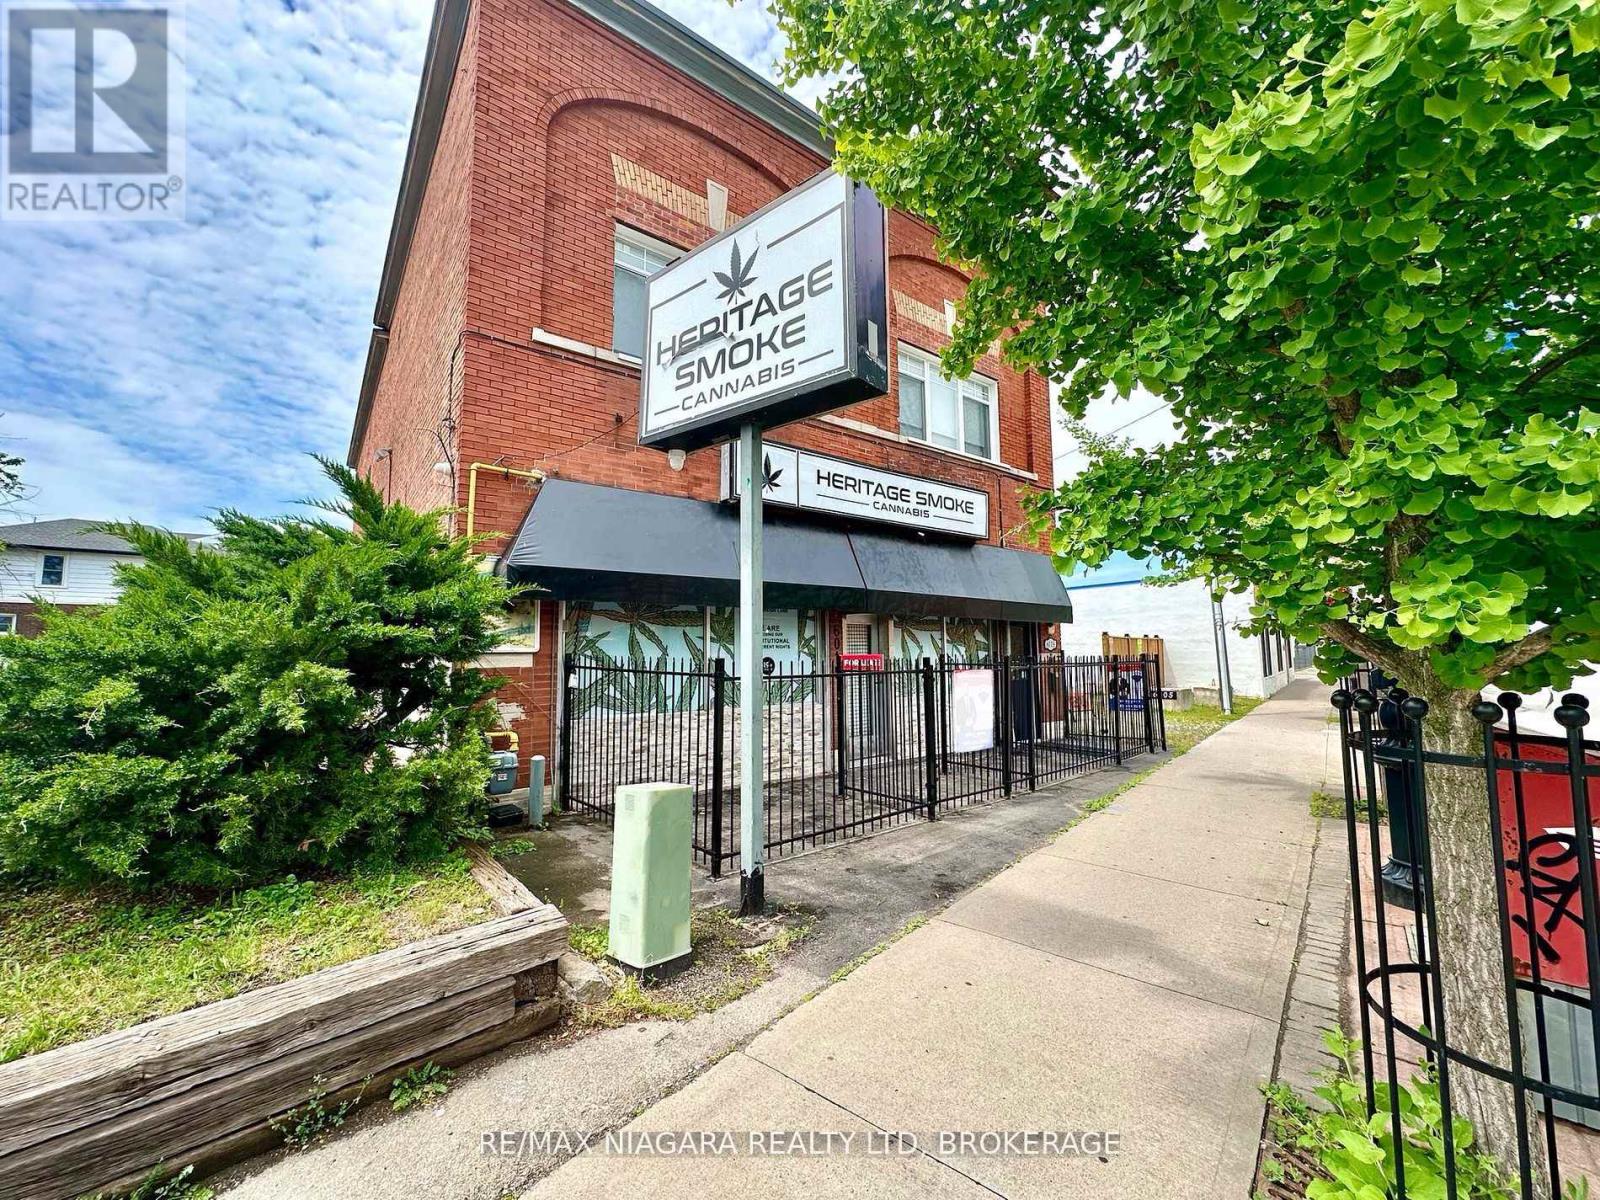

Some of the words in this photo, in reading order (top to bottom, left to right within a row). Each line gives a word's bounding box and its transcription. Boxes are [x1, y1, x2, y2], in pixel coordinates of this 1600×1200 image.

[656, 258, 833, 366] HERITAGE
[674, 313, 806, 392] SMOKE
[681, 358, 795, 411] CANNABIS
[816, 469, 910, 503] HERITAGE
[915, 491, 974, 515] SMOKE
[872, 501, 930, 519] CANNABIS
